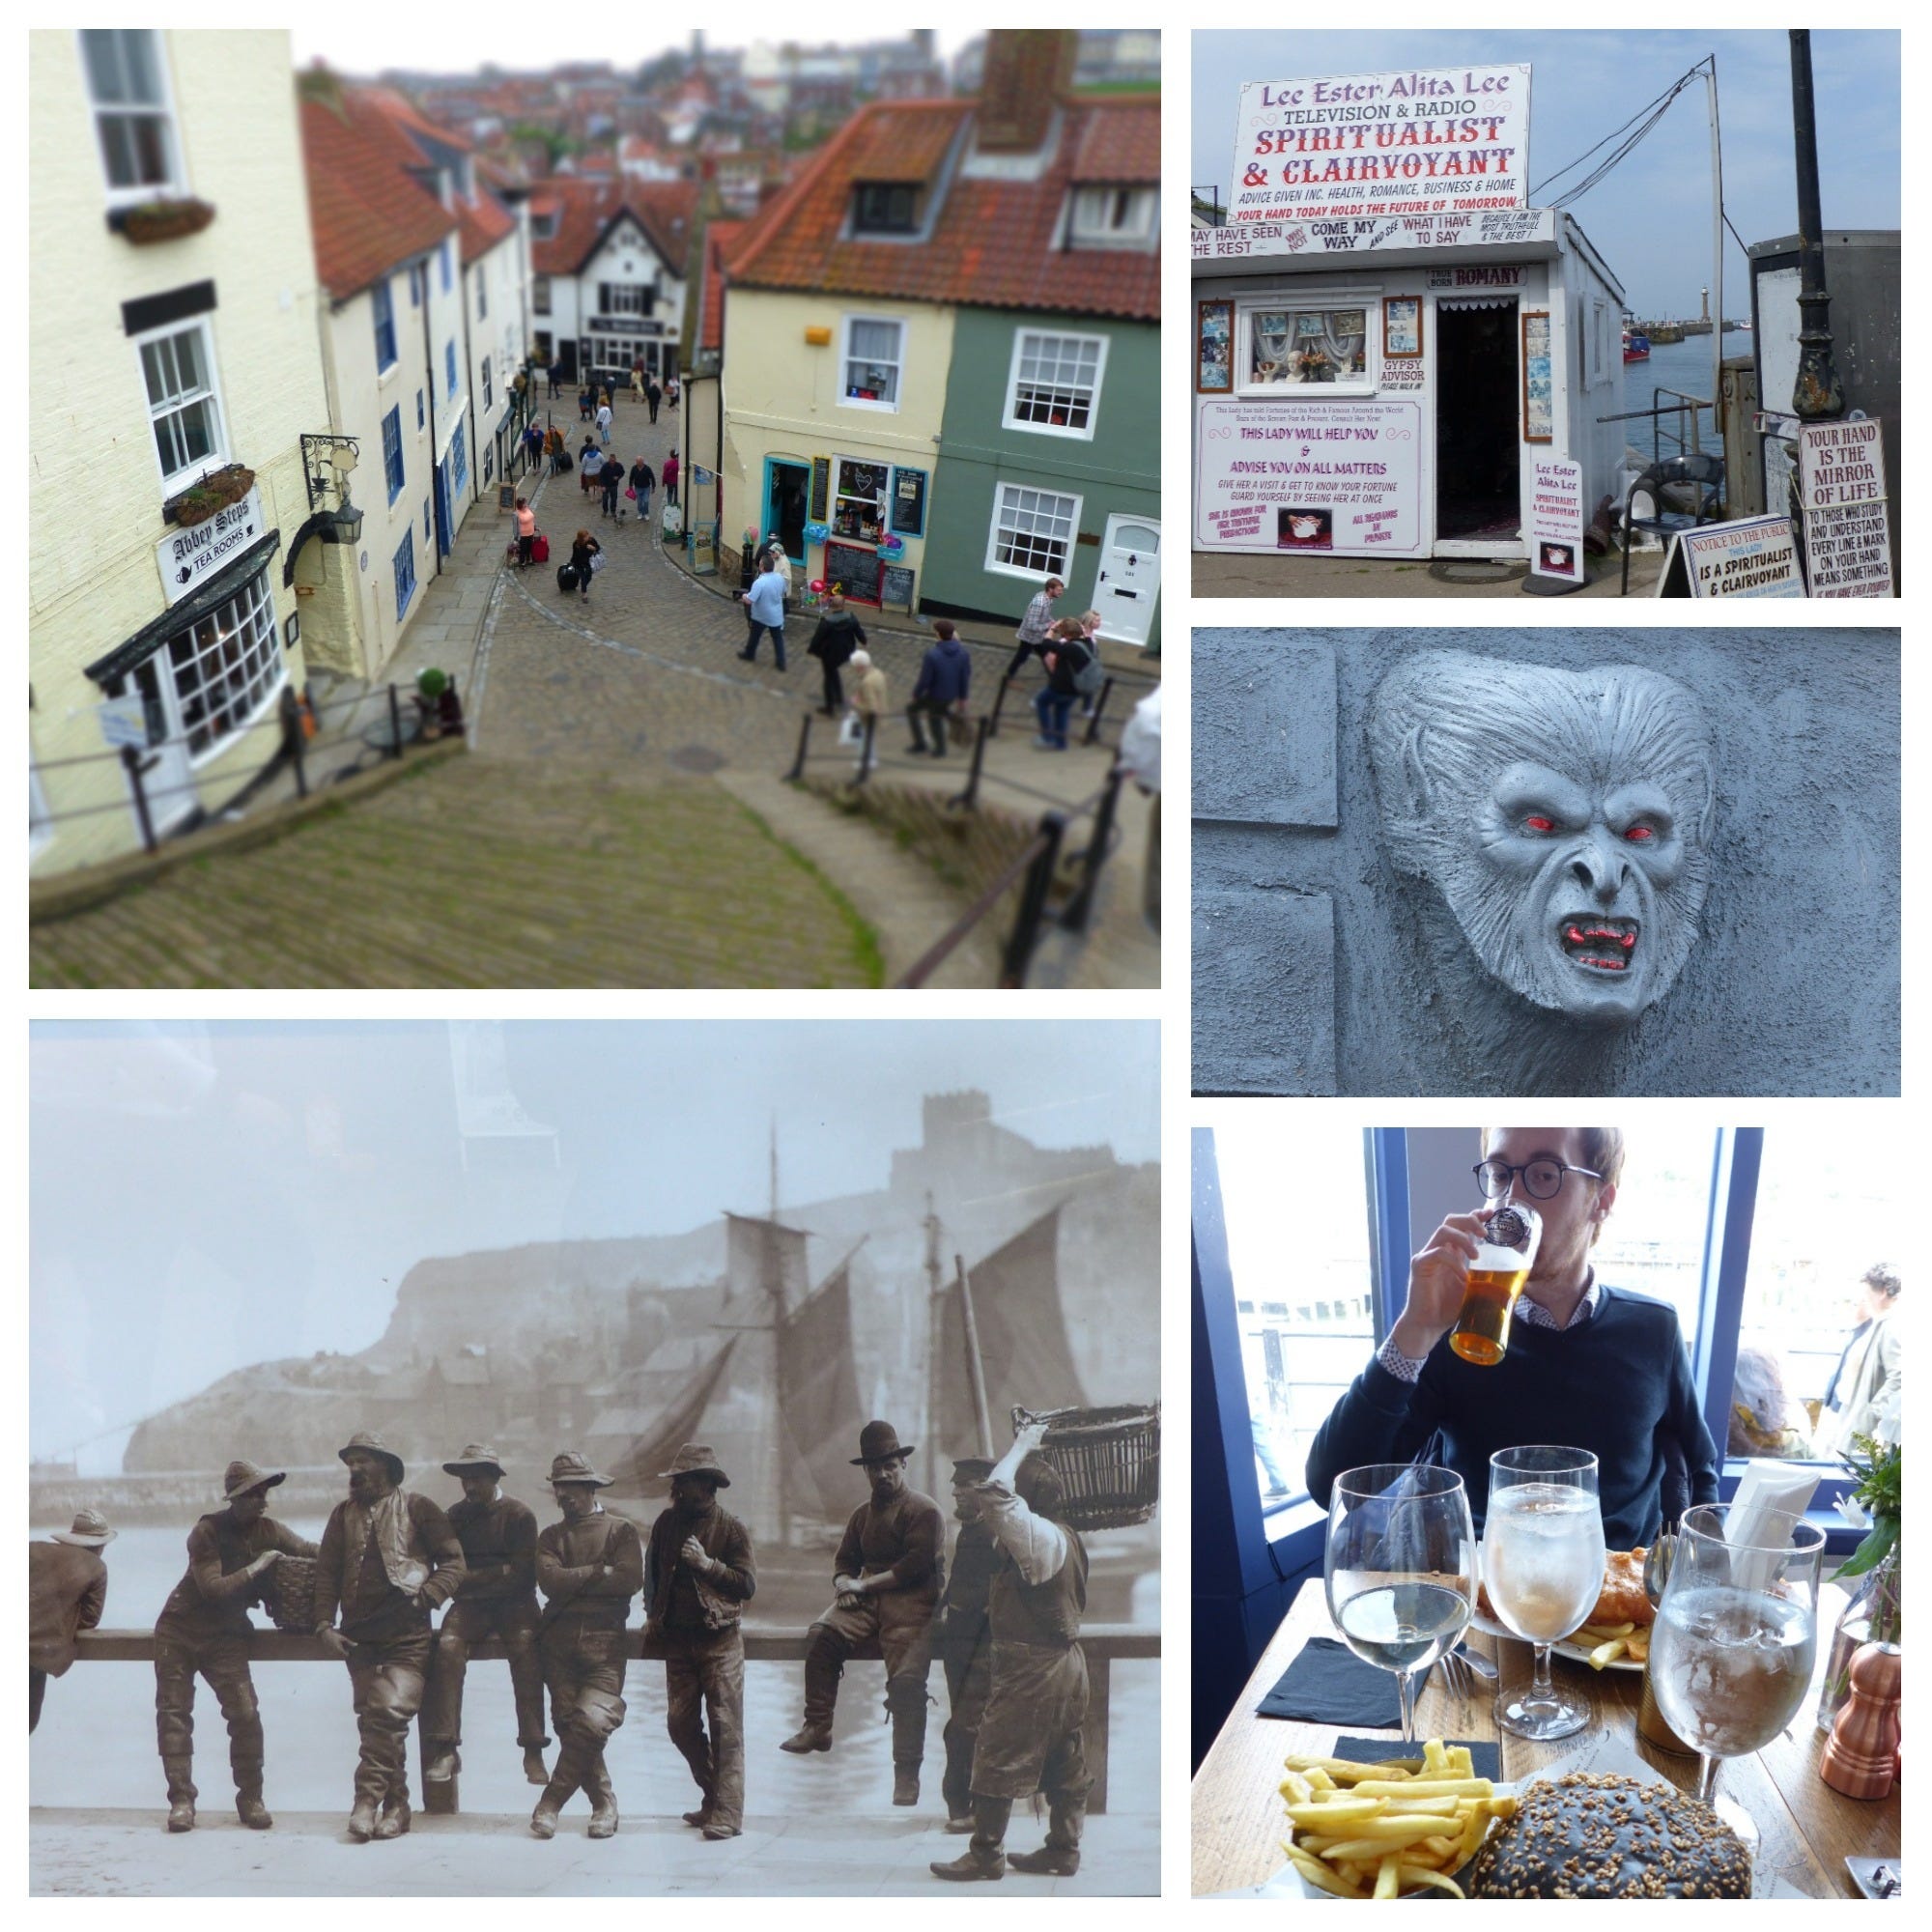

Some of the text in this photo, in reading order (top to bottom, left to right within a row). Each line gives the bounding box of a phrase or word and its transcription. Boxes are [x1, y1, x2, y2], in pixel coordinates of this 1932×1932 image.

[1261, 71, 1510, 108] Lee Ester Alita Lee
[1284, 99, 1476, 125] TELEVISION & RADIO
[1255, 116, 1506, 155] SPIRITUALIST
[1243, 148, 1516, 187] & CLAIRVOYANT
[1238, 179, 1517, 204] ADVICE GIVEN INC. HEALTH, ROMANCE, BUSINESS & HOME
[1236, 196, 1517, 221] YOUR HAND TODAY HOLDS THE FUTURE OF TOMORROW
[1529, 212, 1543, 220] THE
[1312, 220, 1376, 236] COME MY
[1385, 219, 1399, 236] SEE
[1403, 217, 1433, 231] WHAT
[1445, 215, 1471, 228] HAVE
[1216, 229, 1246, 242] HAVE
[1252, 226, 1282, 239] SEEN
[1285, 226, 1306, 242] WHY
[1289, 235, 1308, 251] NOT
[1324, 236, 1358, 249] WAY
[1370, 232, 1384, 249] AND
[1416, 231, 1461, 244] TO SAY
[1191, 242, 1252, 255] HE REST
[1456, 267, 1521, 286] ROMANY
[1384, 360, 1422, 369] GYPSY
[1381, 371, 1425, 381] ADVISOR
[1240, 428, 1378, 440] THIS LADY WILL HELP YOU
[1807, 425, 1876, 448] YOUR HAND
[1300, 445, 1311, 457] &
[1819, 445, 1865, 466] IS THE
[1230, 461, 1387, 474] ADVISE YOU ON ALL MATTERS
[1536, 464, 1577, 476] Lee Ester
[1814, 464, 1875, 486] MIRROR
[1218, 480, 1235, 489] GIVE
[1260, 481, 1279, 490] VISIT
[1289, 481, 1302, 490] GET
[1316, 482, 1339, 491] KNOW
[1341, 482, 1361, 491] YOUR
[1362, 482, 1398, 492] FORTUNE
[1537, 476, 1577, 490] Alita Lee
[1231, 492, 1383, 503] GUARD YOURSELF BY SEEING HER AT ONCE
[1814, 482, 1878, 505] OF LIFE
[1809, 503, 1883, 525] TO THOSE WHO STUDY
[173, 500, 249, 563] Abbey Steps
[1811, 518, 1884, 540] AND UNDERSTAND
[1692, 525, 1788, 553] NOTICE TO THE PUBLIC
[1811, 533, 1886, 555] EVERY LINE & MARK
[194, 528, 243, 570] TEA ROOMS
[1729, 546, 1745, 556] THIS
[1700, 548, 1792, 581] IS A SPIRITUALIST
[1820, 549, 1881, 570] ON YOUR HAND
[1711, 582, 1718, 595] &
[1722, 565, 1790, 593] CLAIRVOYANT
[1814, 562, 1888, 586] MEANS SOMETHING
